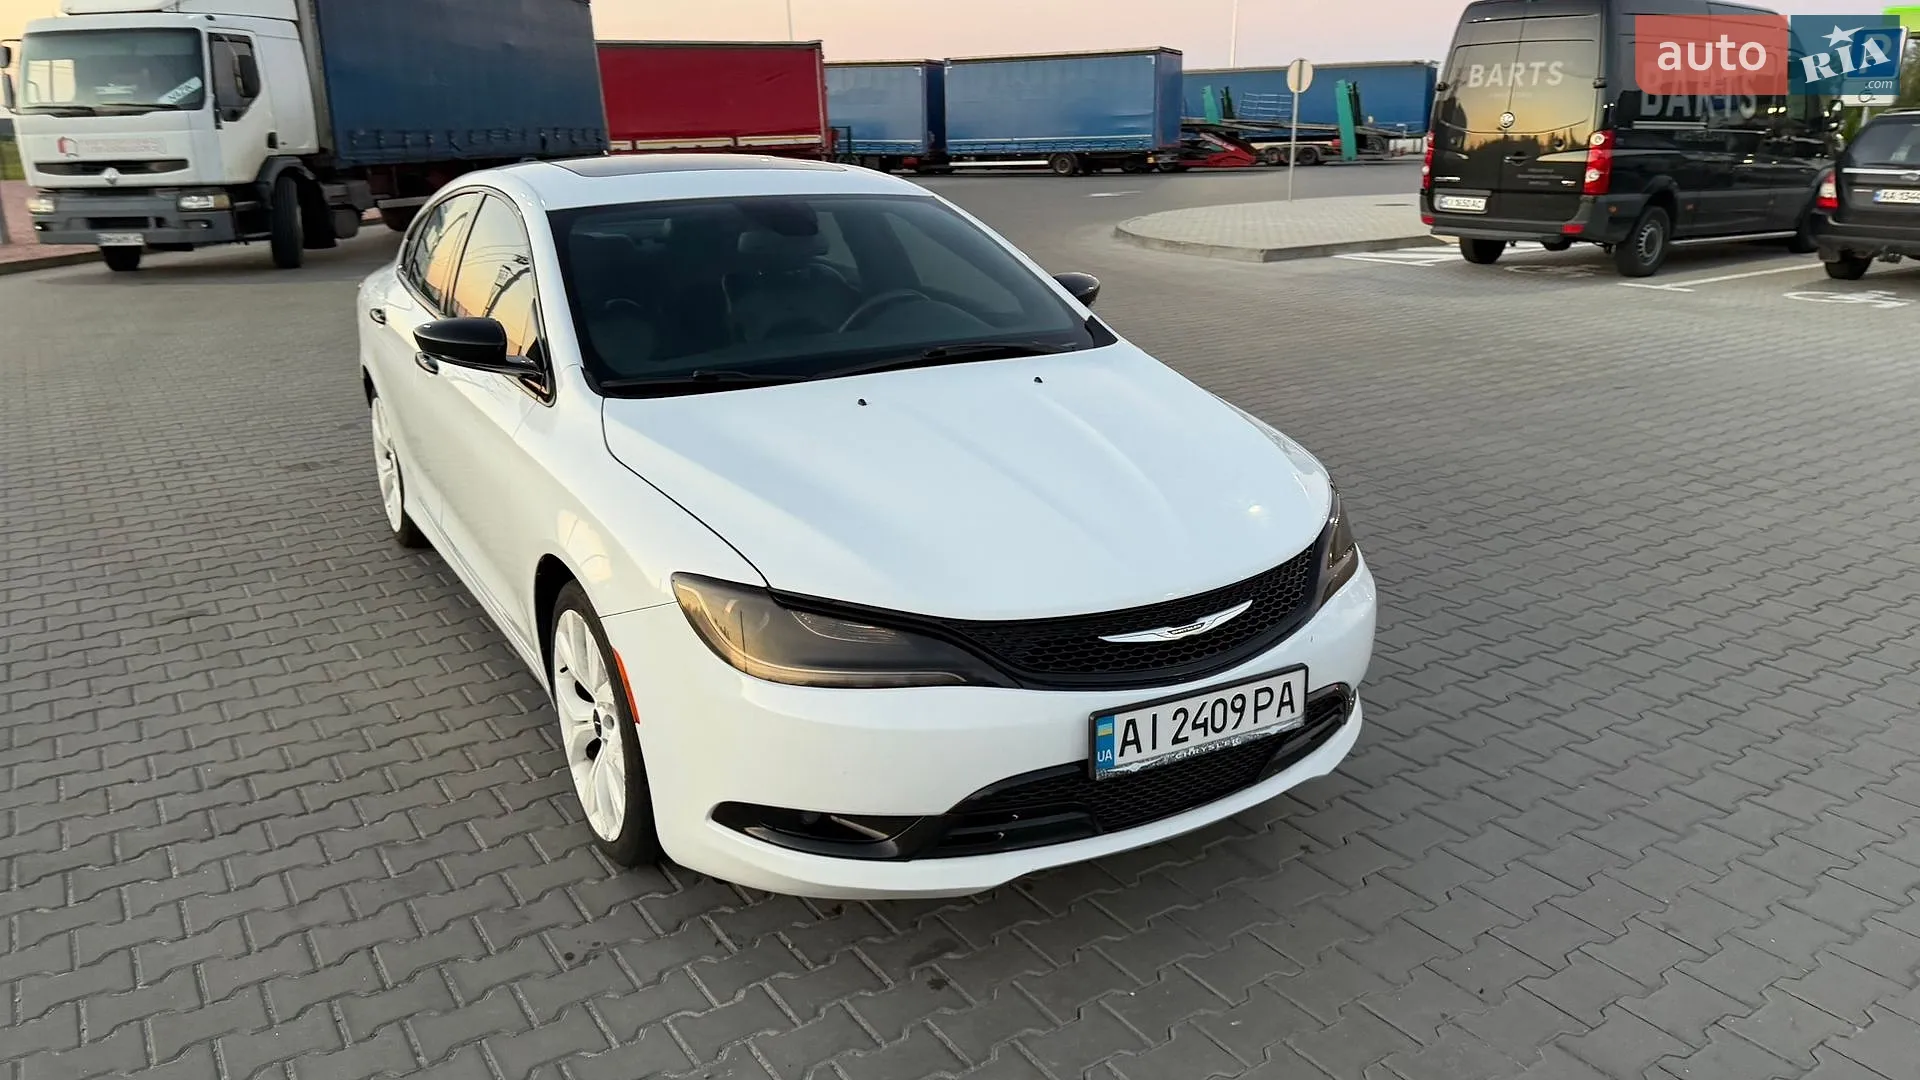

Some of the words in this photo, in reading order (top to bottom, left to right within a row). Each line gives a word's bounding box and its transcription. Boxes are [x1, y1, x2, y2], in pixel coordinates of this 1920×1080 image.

[1466, 60, 1564, 89] BARTS
[1118, 713, 1158, 758] AI
[1171, 693, 1247, 746] 2409
[1253, 681, 1295, 724] PA
[1097, 749, 1113, 762] UA
